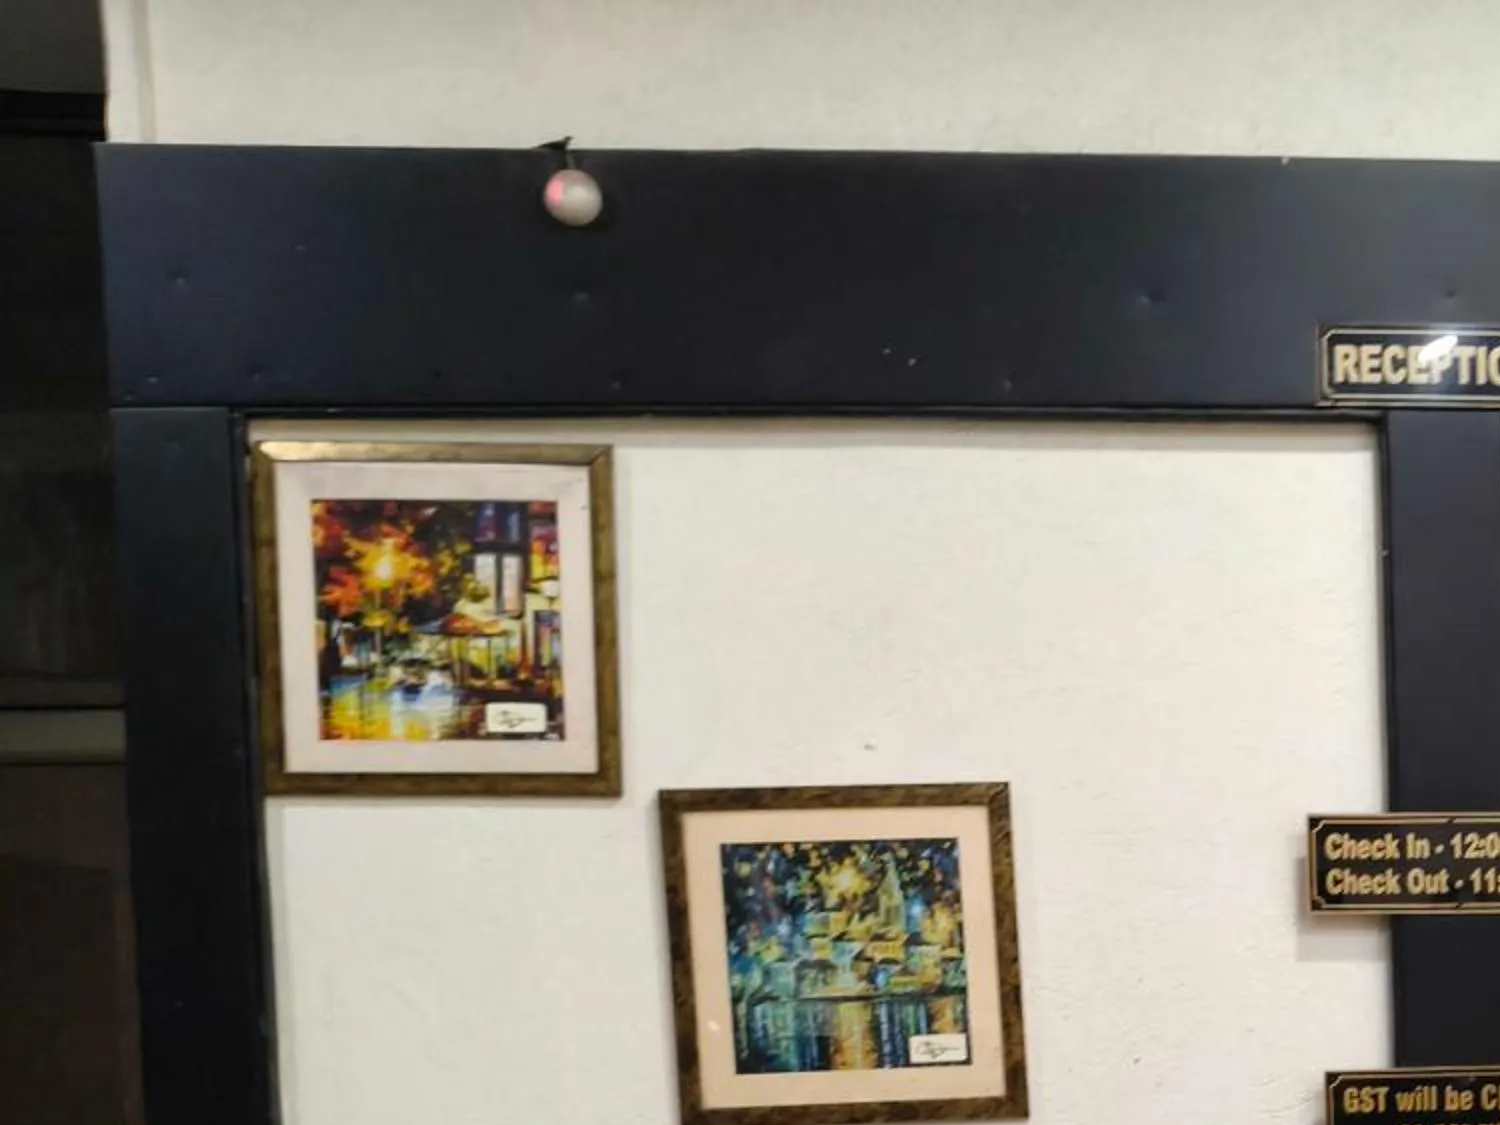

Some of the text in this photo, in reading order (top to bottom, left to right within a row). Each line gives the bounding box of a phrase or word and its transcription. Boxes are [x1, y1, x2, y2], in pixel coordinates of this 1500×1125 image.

[1324, 832, 1400, 860] Check
[1406, 833, 1431, 860] In
[1326, 867, 1400, 895] Check
[1407, 867, 1449, 894] Out
[1343, 1086, 1389, 1113] GST
[1395, 1086, 1437, 1112] will
[1444, 1085, 1473, 1111] be
